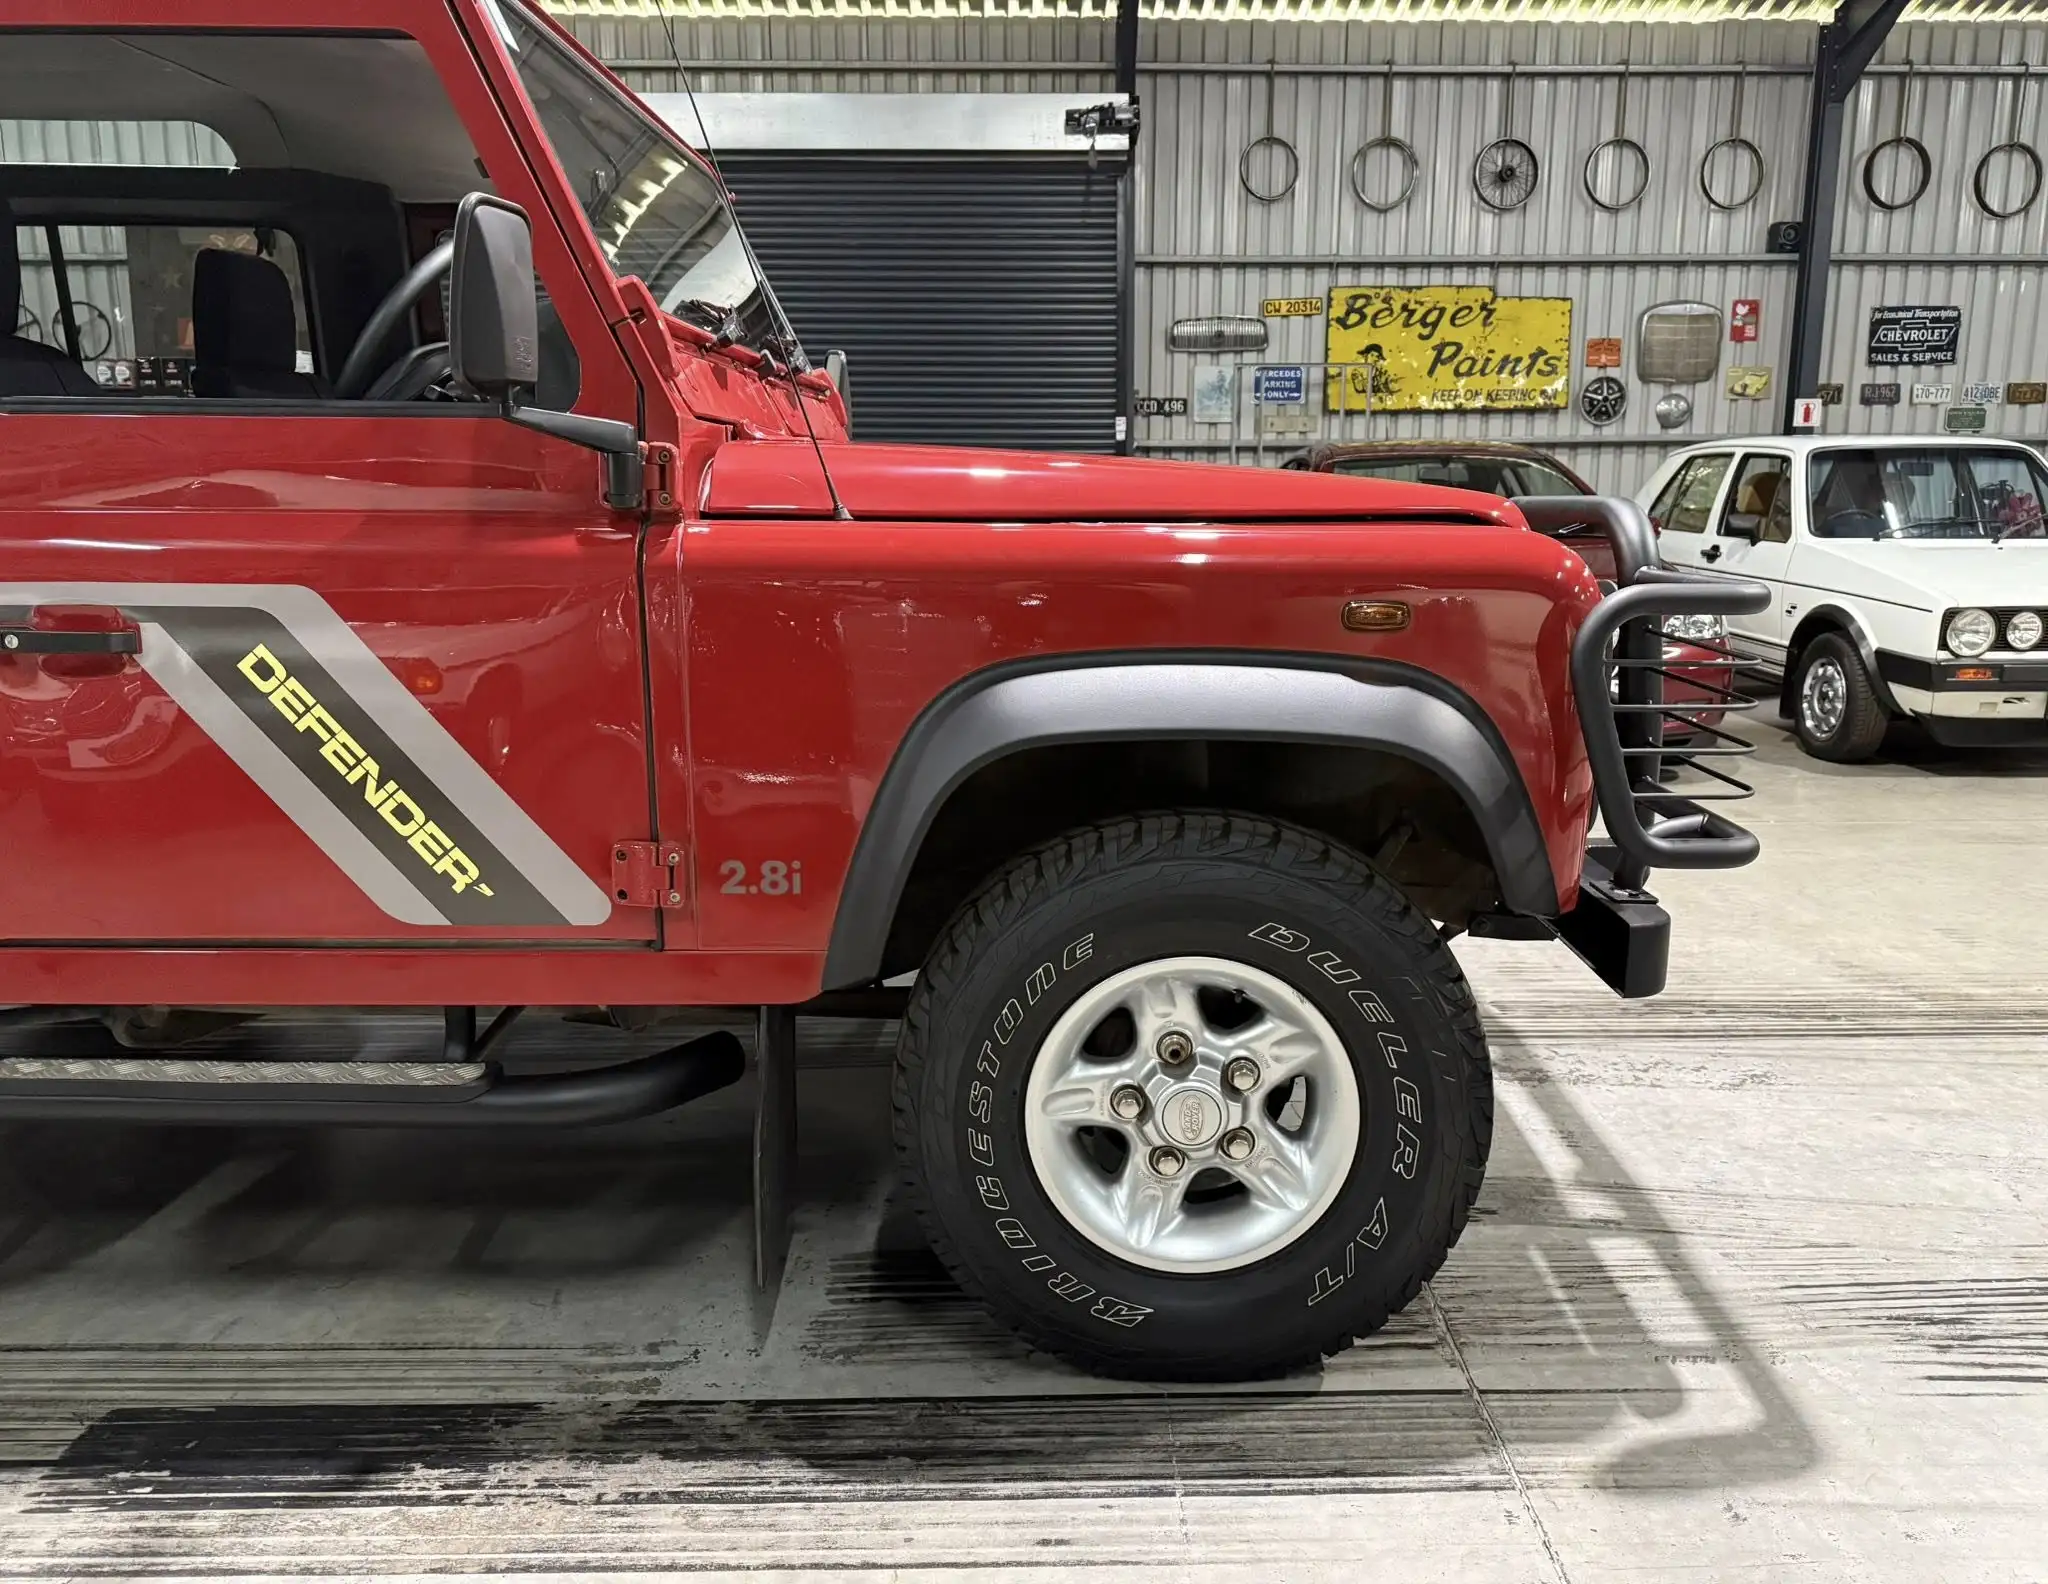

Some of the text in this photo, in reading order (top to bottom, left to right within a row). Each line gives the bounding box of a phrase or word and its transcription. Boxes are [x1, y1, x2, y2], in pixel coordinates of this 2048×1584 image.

[1265, 301, 1320, 314] CW 20314
[1335, 292, 1497, 341] Berger
[1880, 329, 1949, 342] CHEVROLET
[1427, 341, 1563, 379] Paints
[1870, 352, 1953, 362] SALES & SERVICE
[1164, 400, 1185, 413] 496
[237, 643, 480, 894] DEFENDER
[719, 860, 801, 895] 2.8i
[968, 933, 1155, 1328] BRIDGESTONE
[1191, 1101, 1201, 1131] ROVER
[1248, 922, 1422, 1307] DUELER A/T
